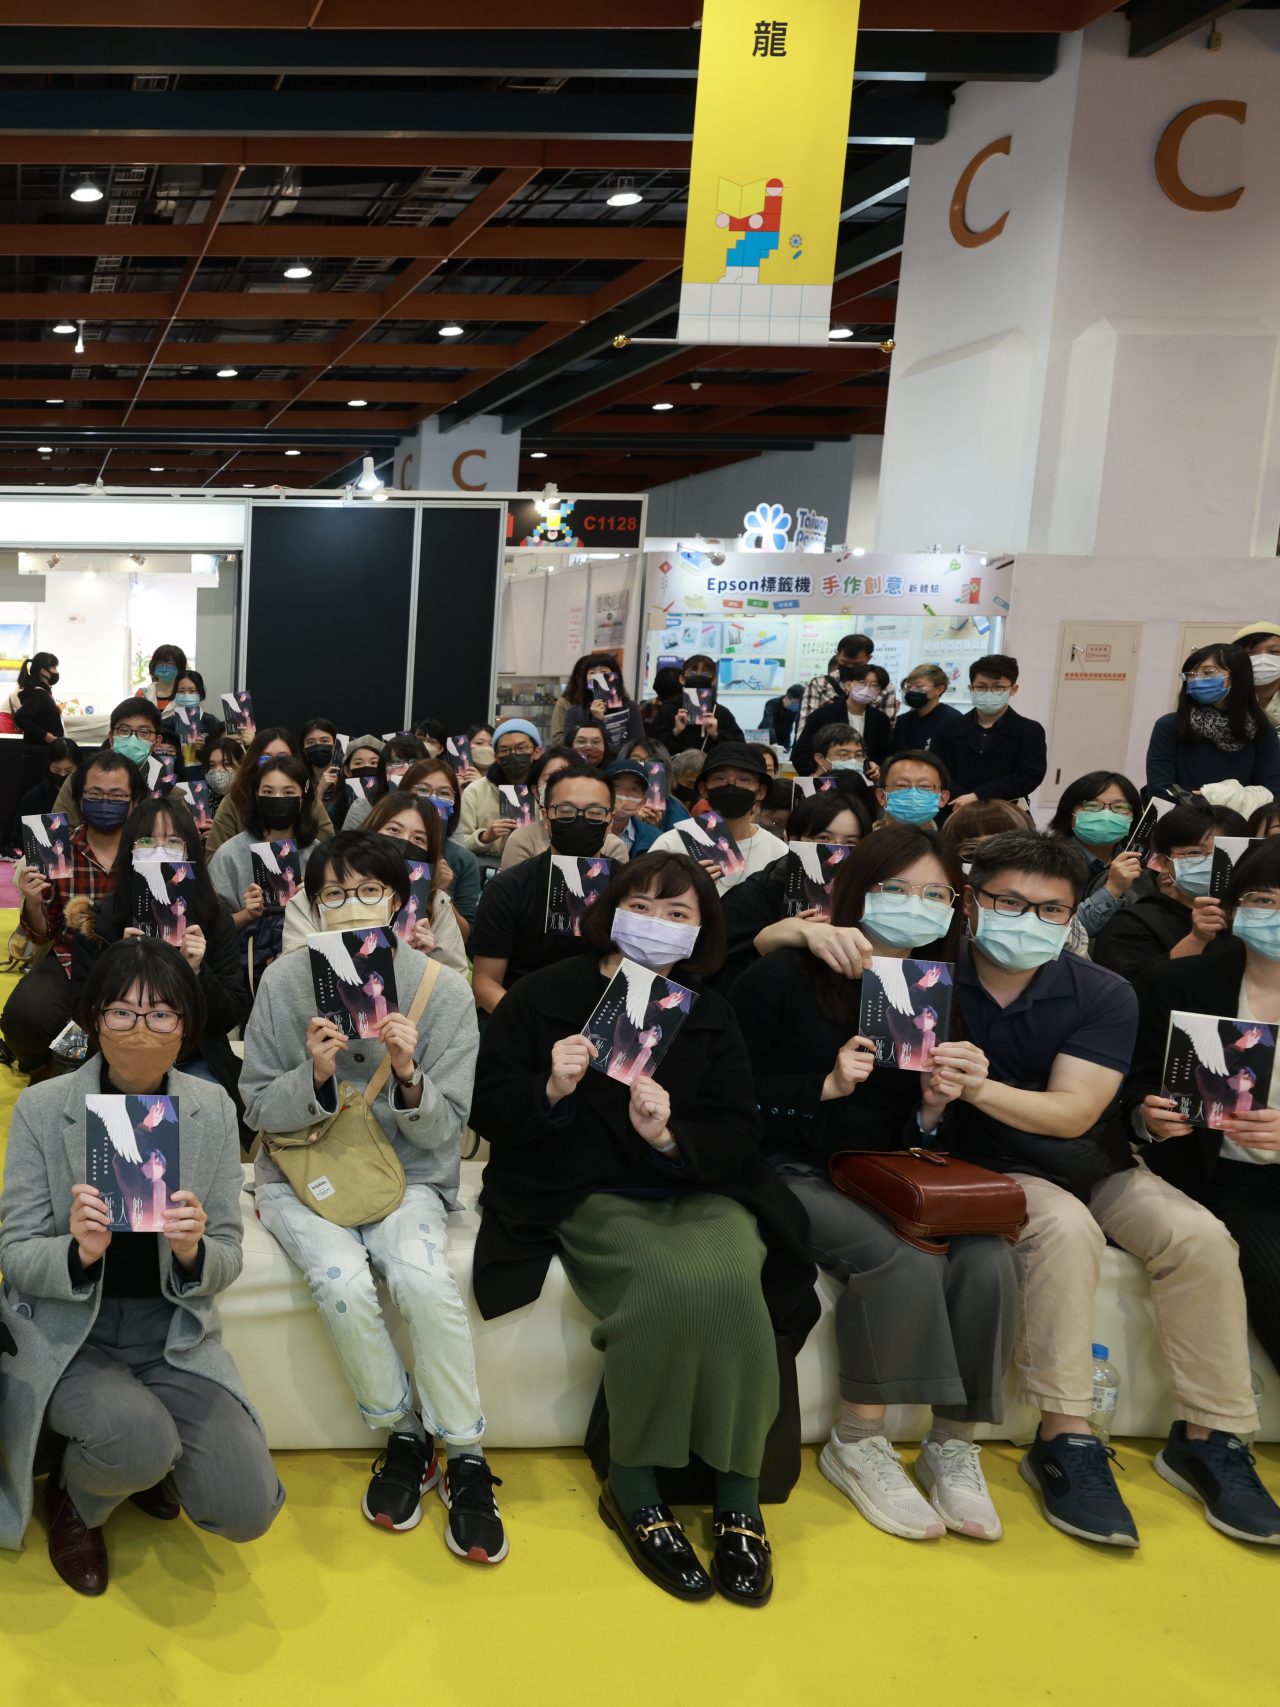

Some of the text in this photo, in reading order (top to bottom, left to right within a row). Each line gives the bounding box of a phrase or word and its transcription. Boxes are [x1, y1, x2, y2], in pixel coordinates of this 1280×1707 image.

[752, 19, 788, 58] 龍
[1155, 100, 1248, 211] C
[949, 135, 1012, 248] C
[452, 449, 487, 491] C
[583, 515, 636, 531] C1128
[822, 575, 903, 595] 手作創意
